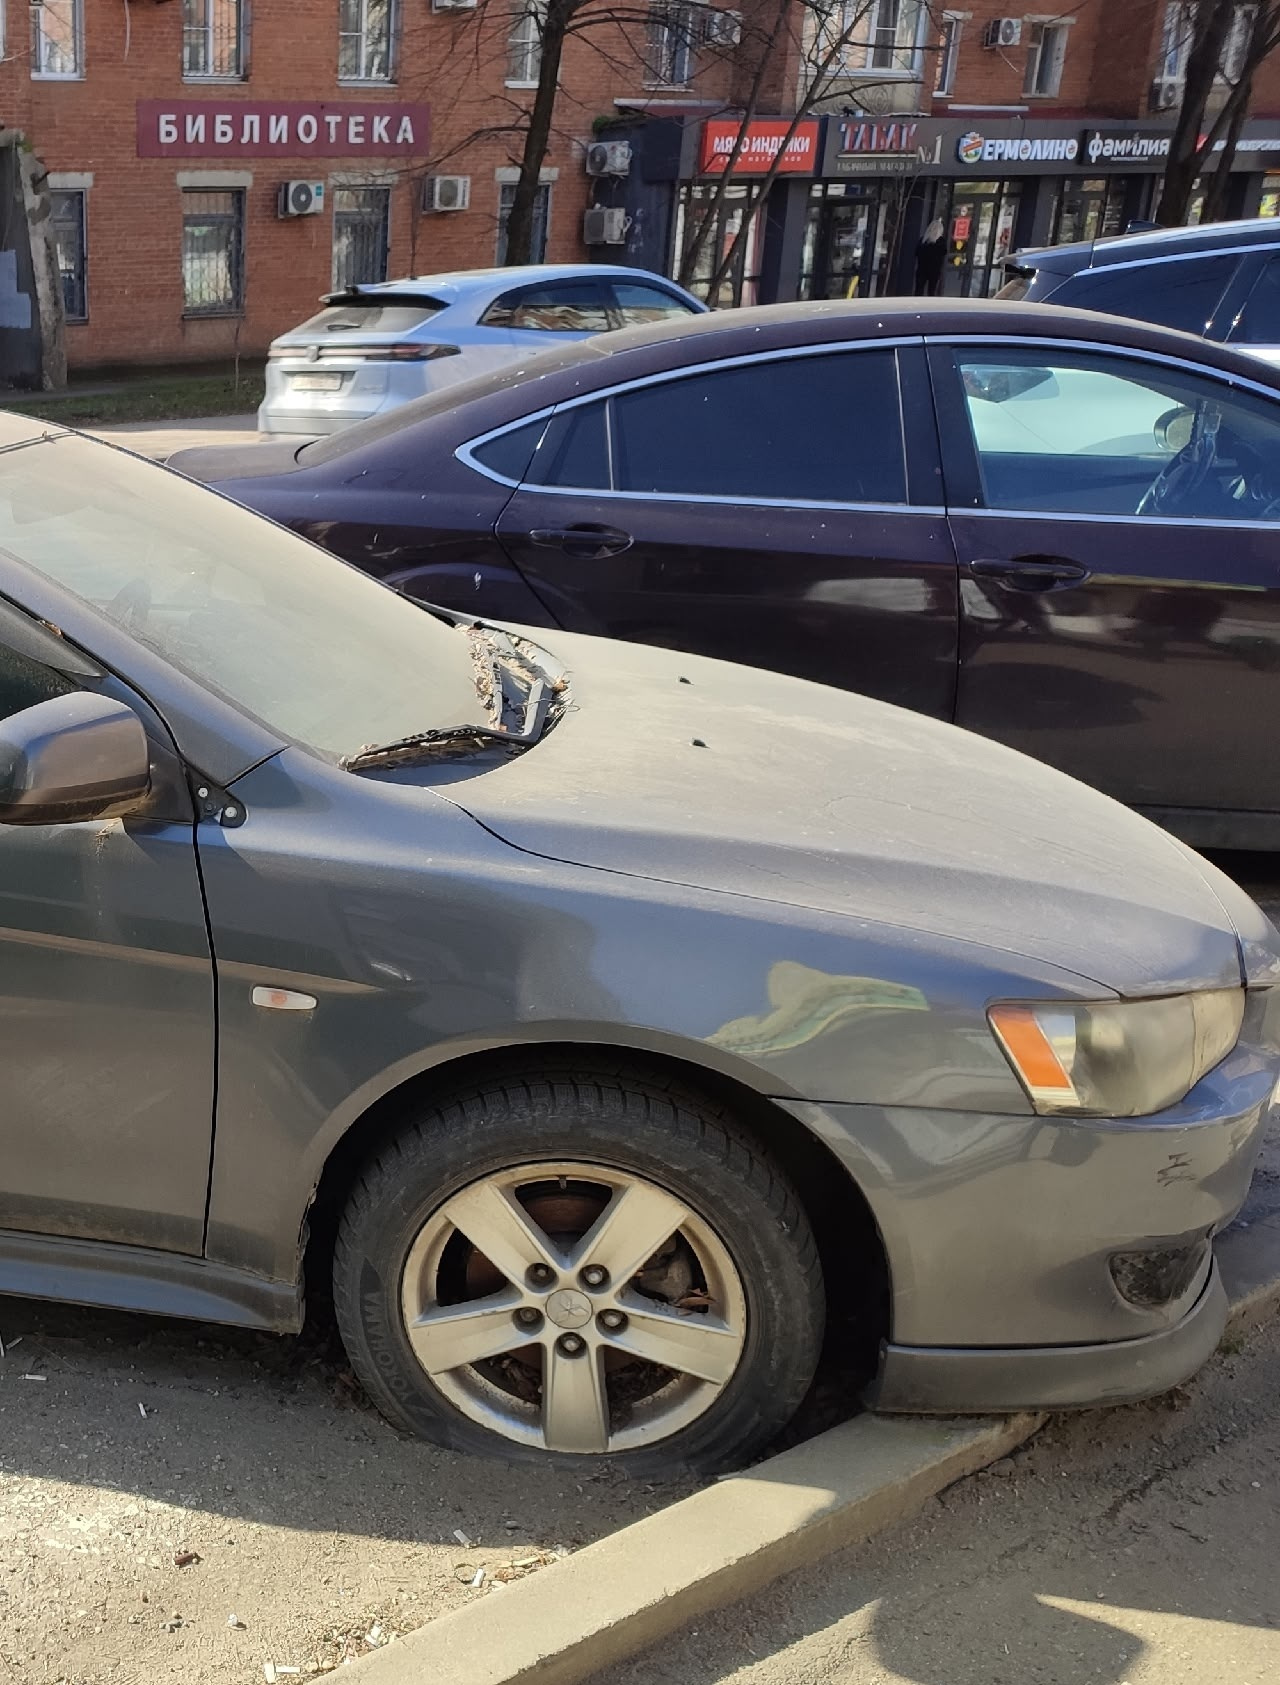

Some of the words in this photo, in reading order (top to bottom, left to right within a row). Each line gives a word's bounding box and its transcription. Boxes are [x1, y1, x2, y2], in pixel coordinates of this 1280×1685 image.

[158, 114, 415, 144] БИБЛИОТЕКА
[840, 123, 917, 151] ТАБАК
[981, 138, 1078, 160] ЕРМОЛИНО
[1088, 132, 1170, 164] фамилия
[364, 1291, 412, 1402] YOKOHAMA
